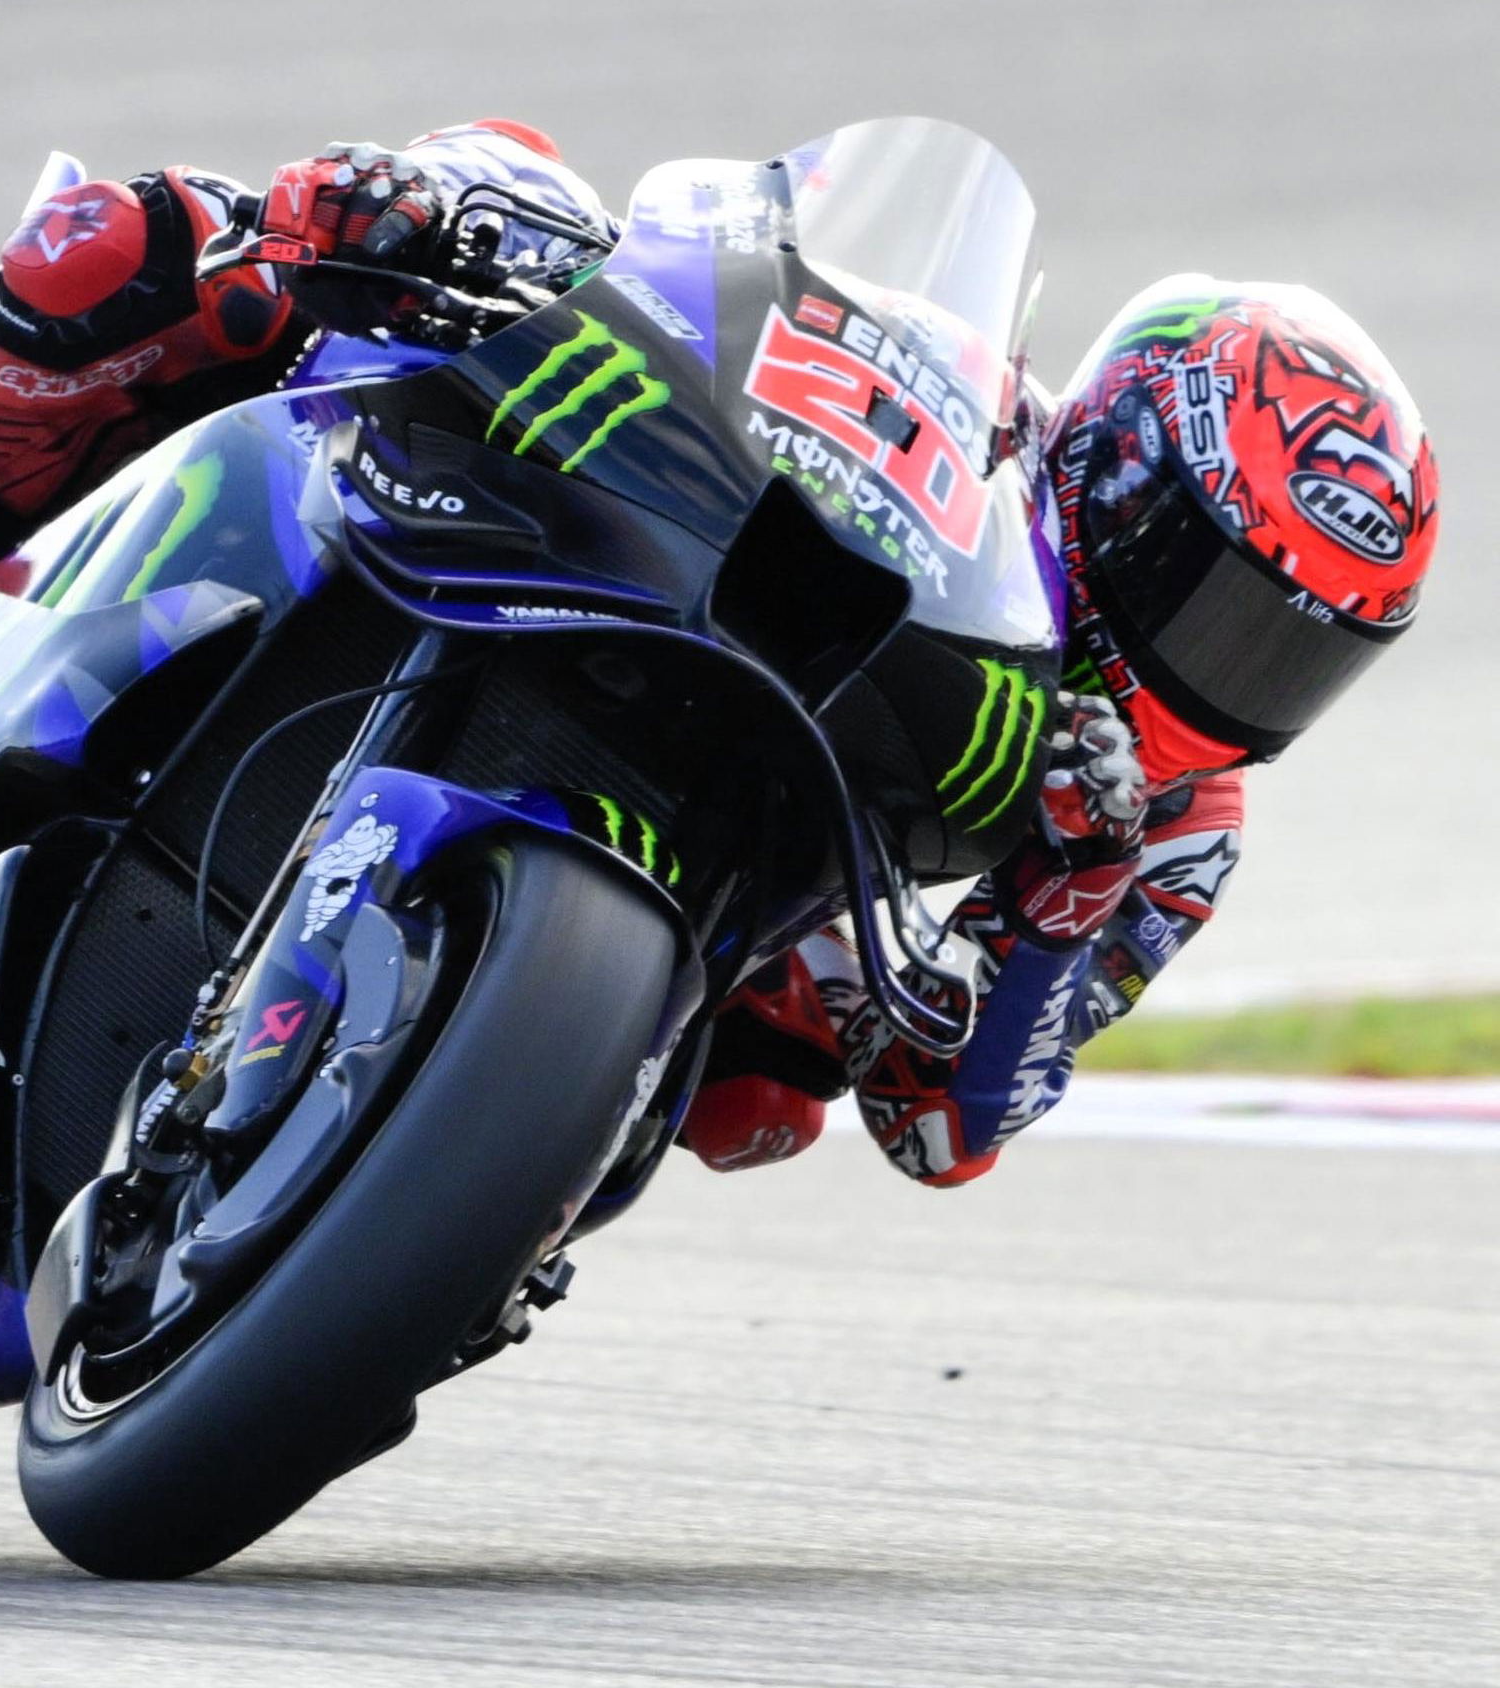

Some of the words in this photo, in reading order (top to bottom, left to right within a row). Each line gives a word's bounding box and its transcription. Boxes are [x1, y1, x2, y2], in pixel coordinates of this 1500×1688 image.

[841, 314, 992, 476] ENEOS
[747, 411, 948, 598] MONSTER
[771, 455, 924, 577] ENERGY
[1304, 484, 1397, 550] HJC
